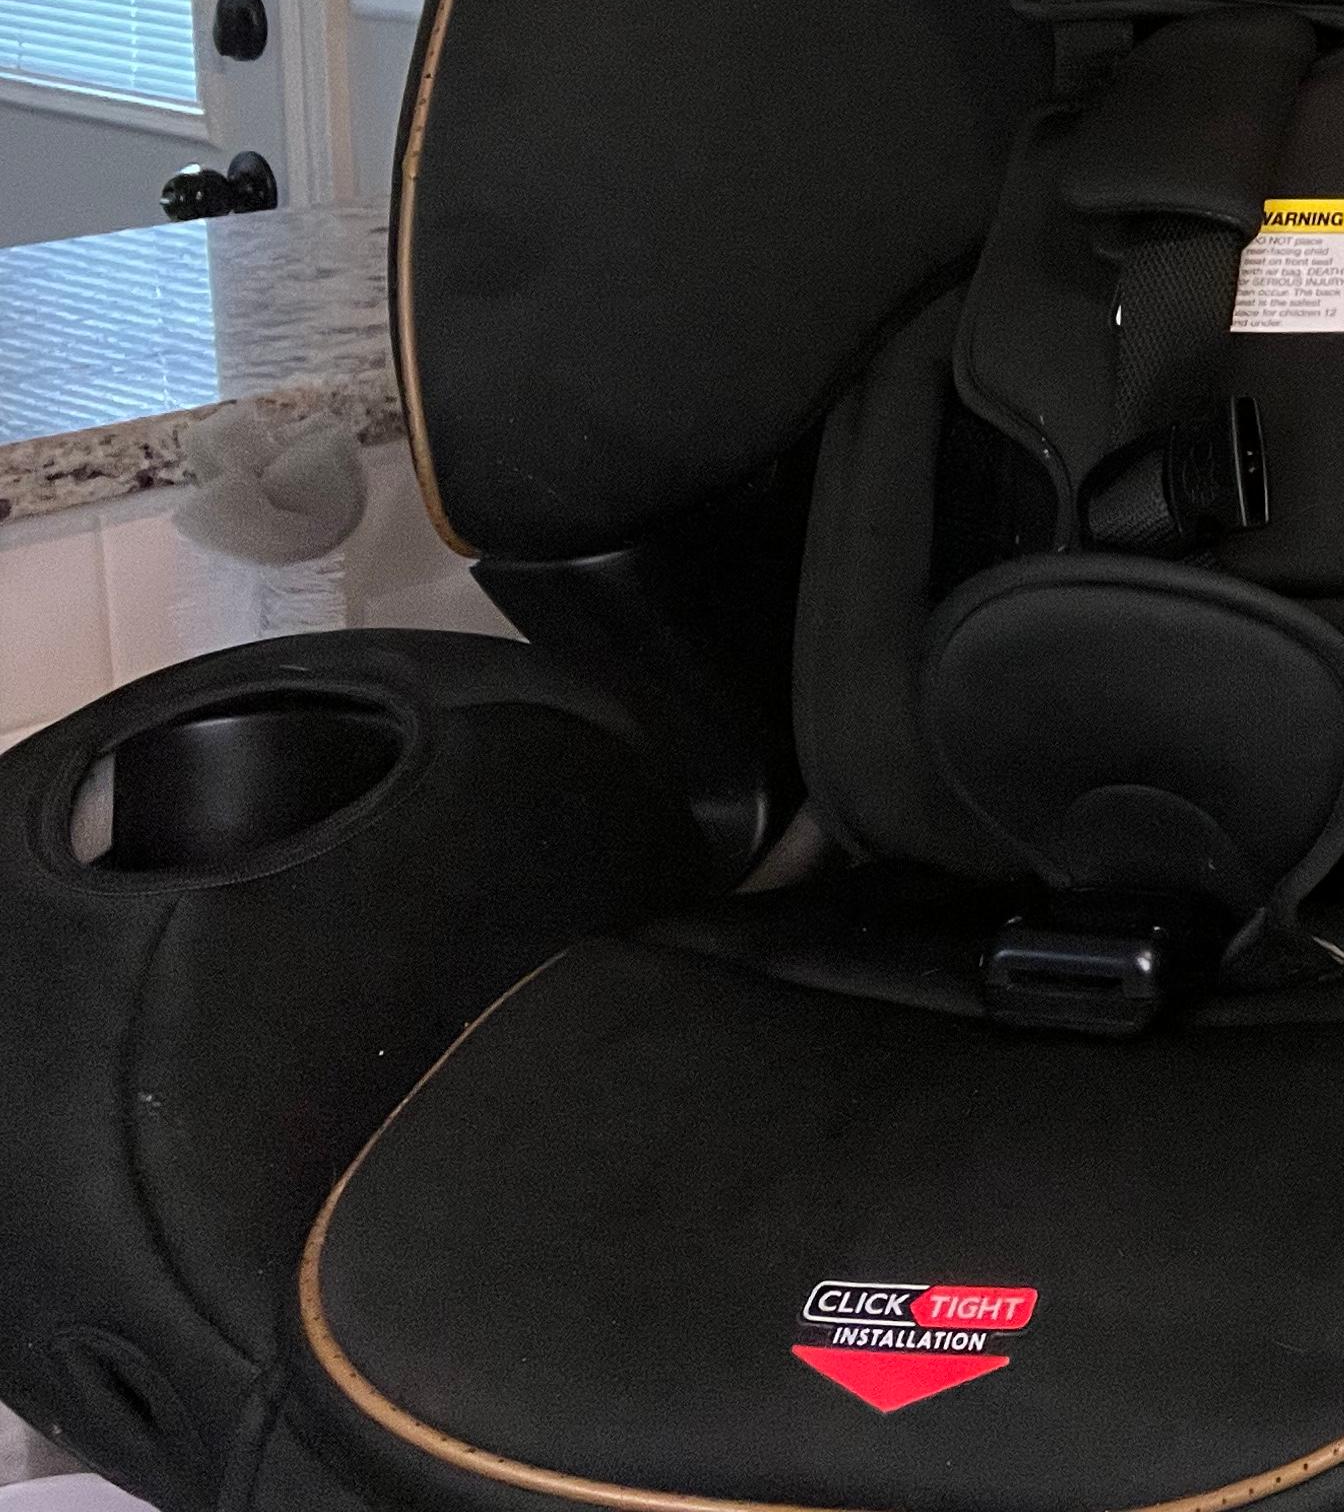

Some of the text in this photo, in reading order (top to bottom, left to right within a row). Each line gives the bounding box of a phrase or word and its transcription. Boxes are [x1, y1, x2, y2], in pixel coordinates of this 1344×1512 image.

[1285, 258, 1308, 266] front
[1253, 278, 1302, 286] SERIOUS
[817, 1289, 1025, 1321] CLICK TIGHT
[832, 1326, 988, 1351] INSTALLATION
